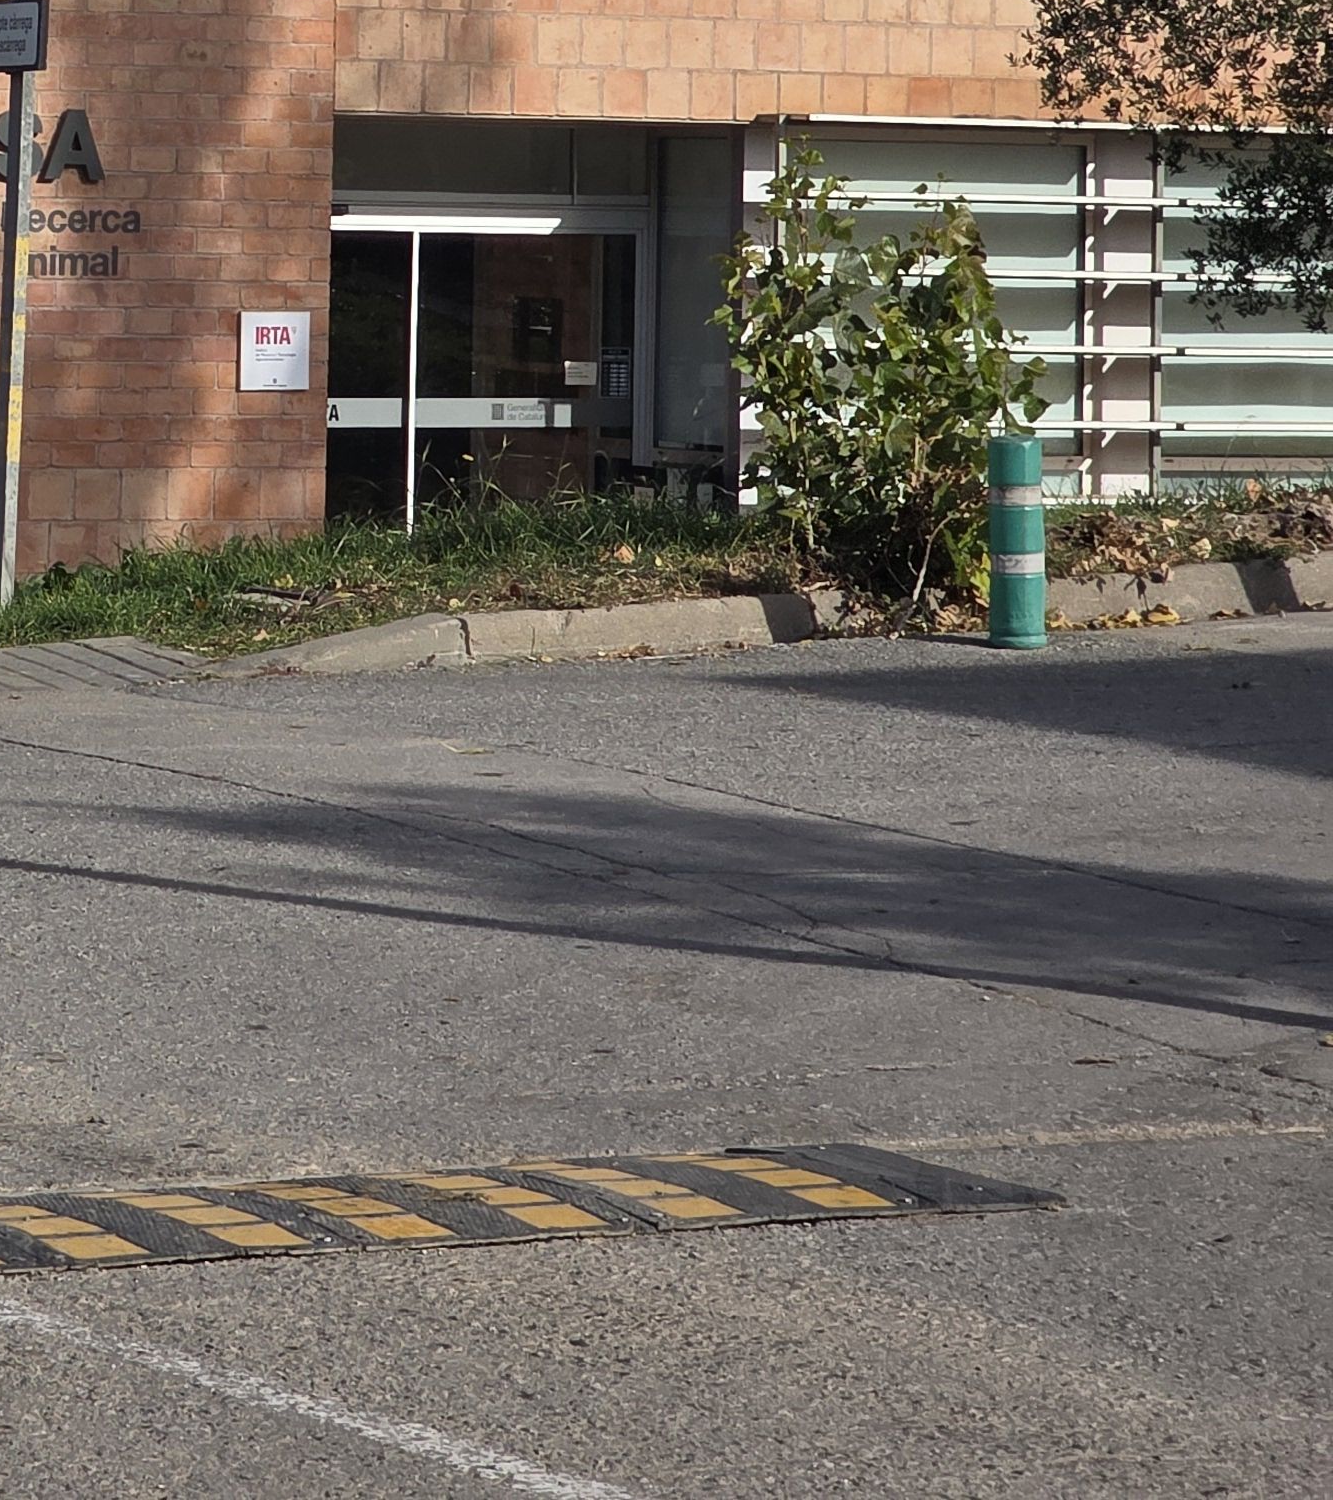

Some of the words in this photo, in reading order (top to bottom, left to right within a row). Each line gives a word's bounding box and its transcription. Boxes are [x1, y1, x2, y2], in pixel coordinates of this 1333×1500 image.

[1, 201, 141, 233] ecerca
[23, 245, 118, 277] nimal
[255, 326, 291, 345] IRTA
